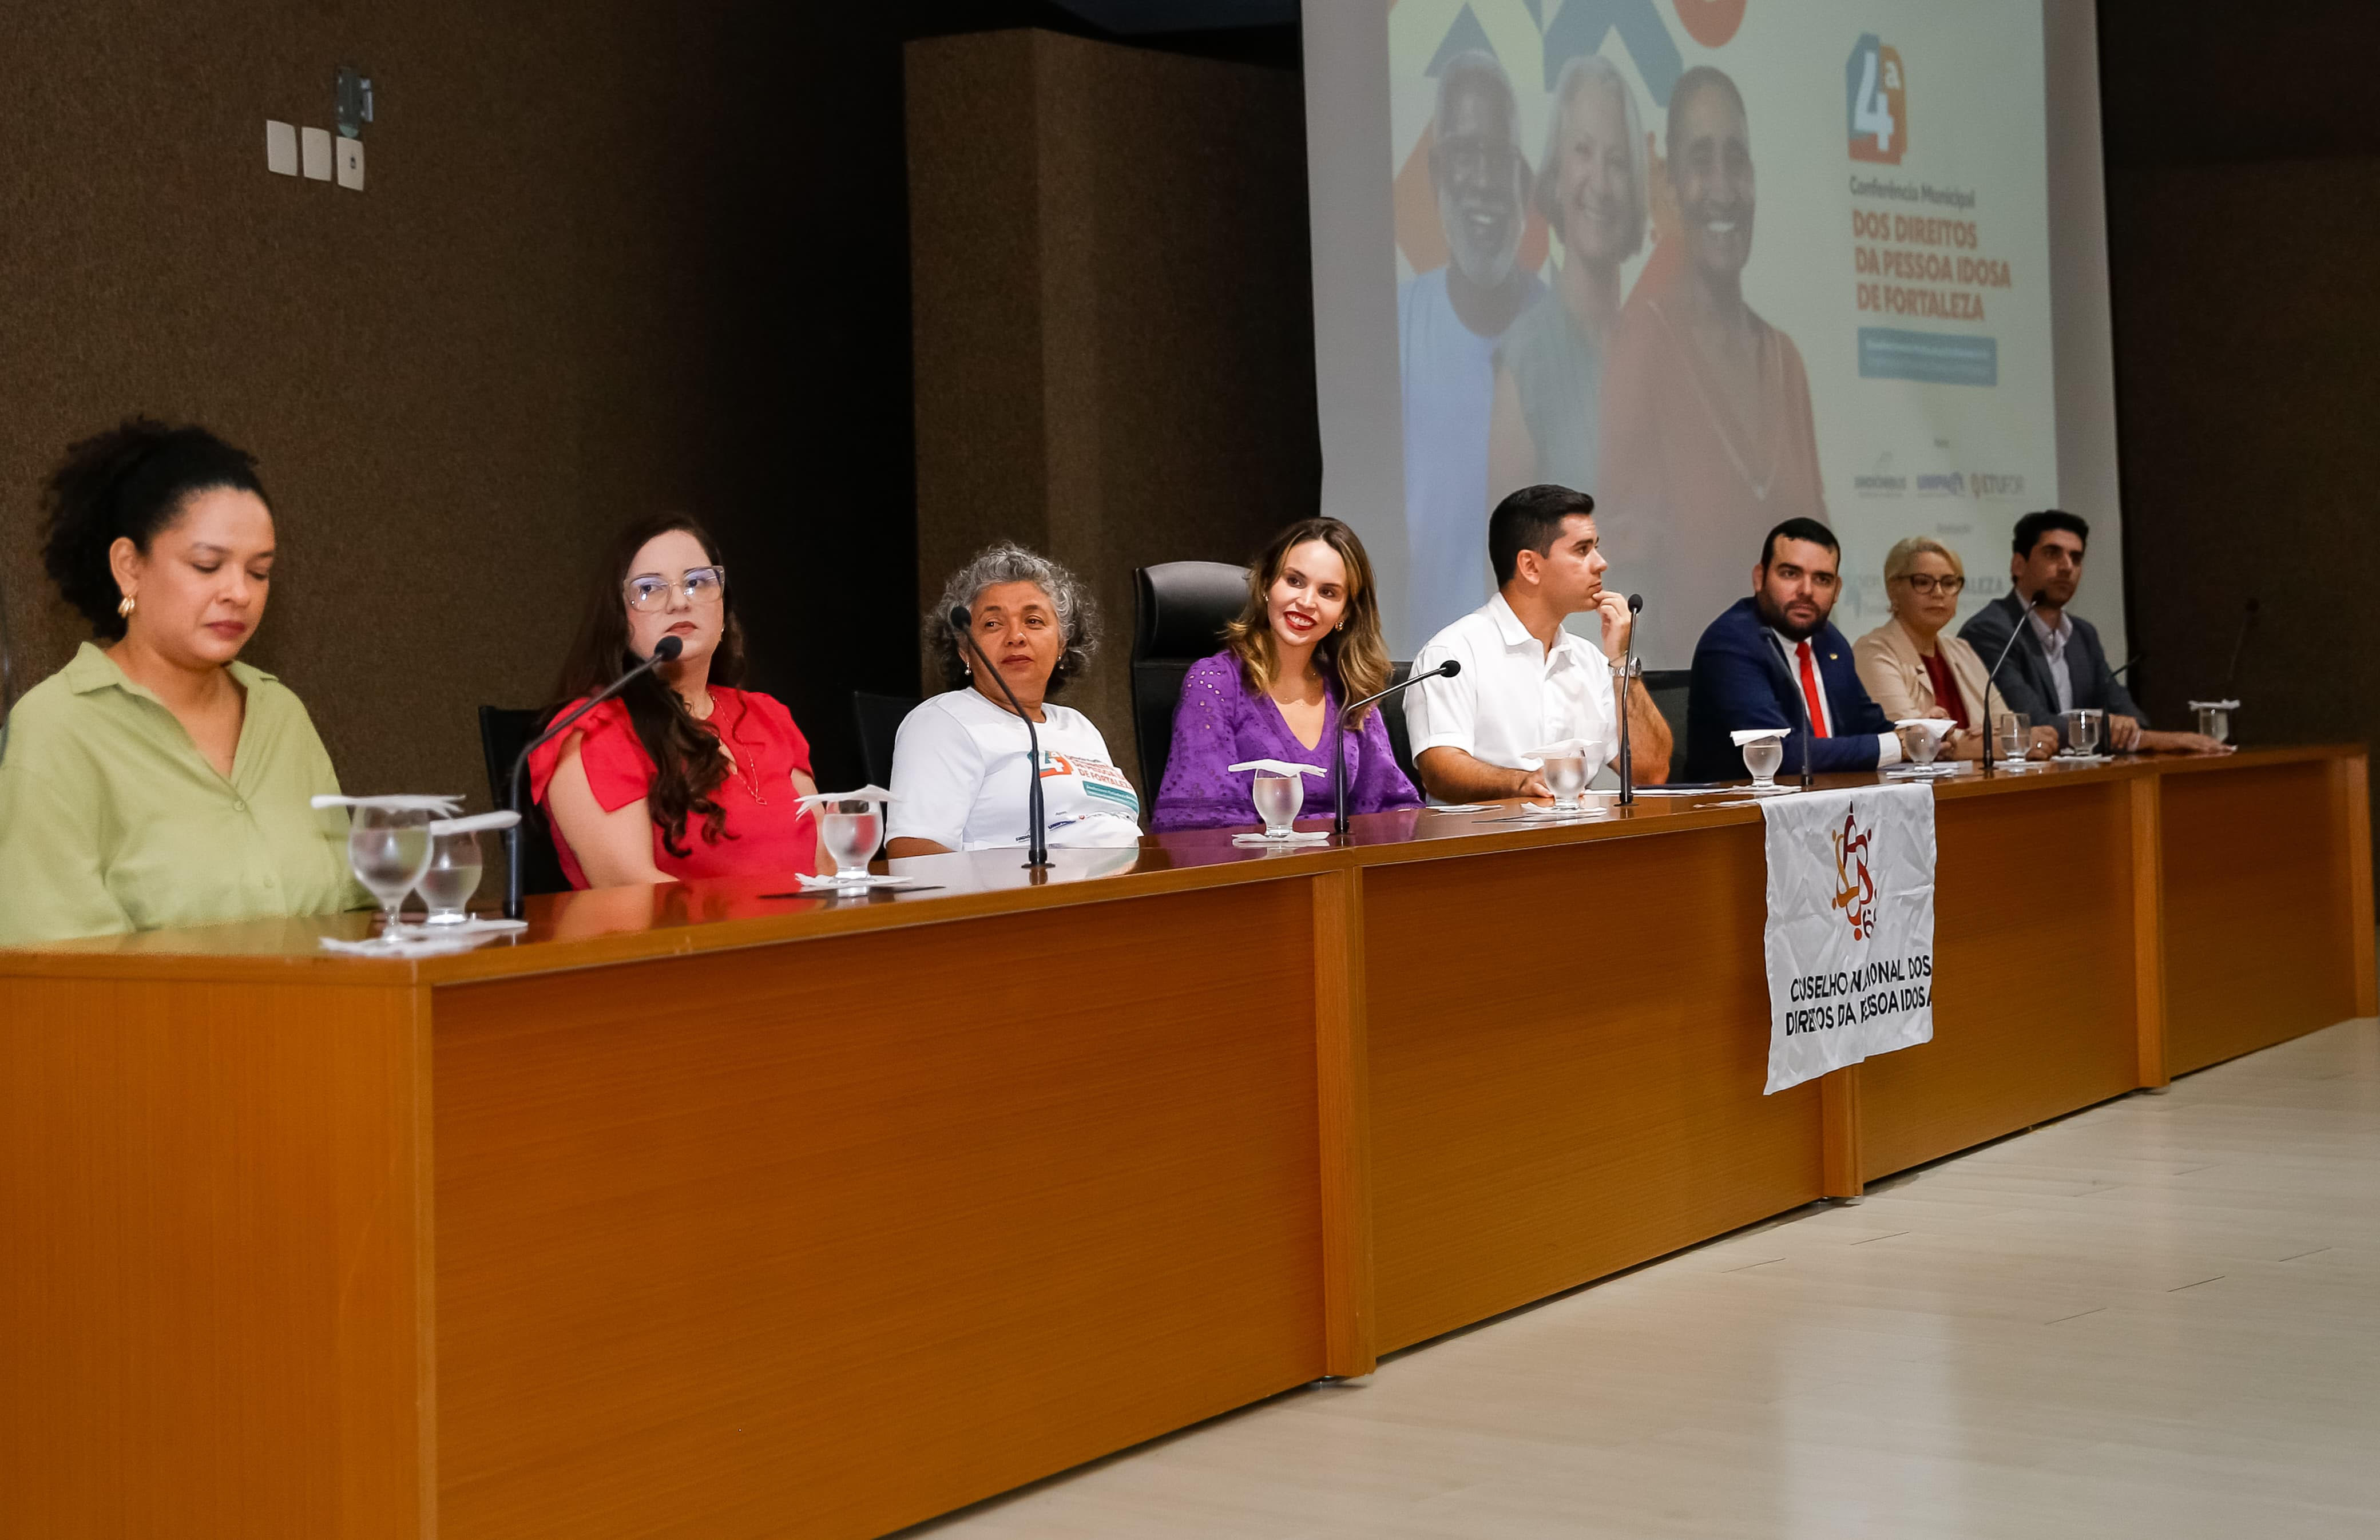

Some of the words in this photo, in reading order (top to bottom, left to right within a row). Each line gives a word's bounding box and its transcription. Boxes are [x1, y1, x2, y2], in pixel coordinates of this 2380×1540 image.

[1851, 209, 1890, 241] DOS
[1895, 214, 1978, 249] DIREITOS
[1855, 247, 1880, 275] DA
[1883, 248, 1953, 281] PESSOA
[1957, 256, 2012, 288] IDOSA
[1857, 283, 1881, 312] DE
[1884, 285, 1984, 320] FORTALEZA
[1078, 768, 1090, 778] DE
[1090, 771, 1133, 790] FORTALEZ
[1908, 955, 1931, 979] DOS
[1838, 1002, 1857, 1027] DA
